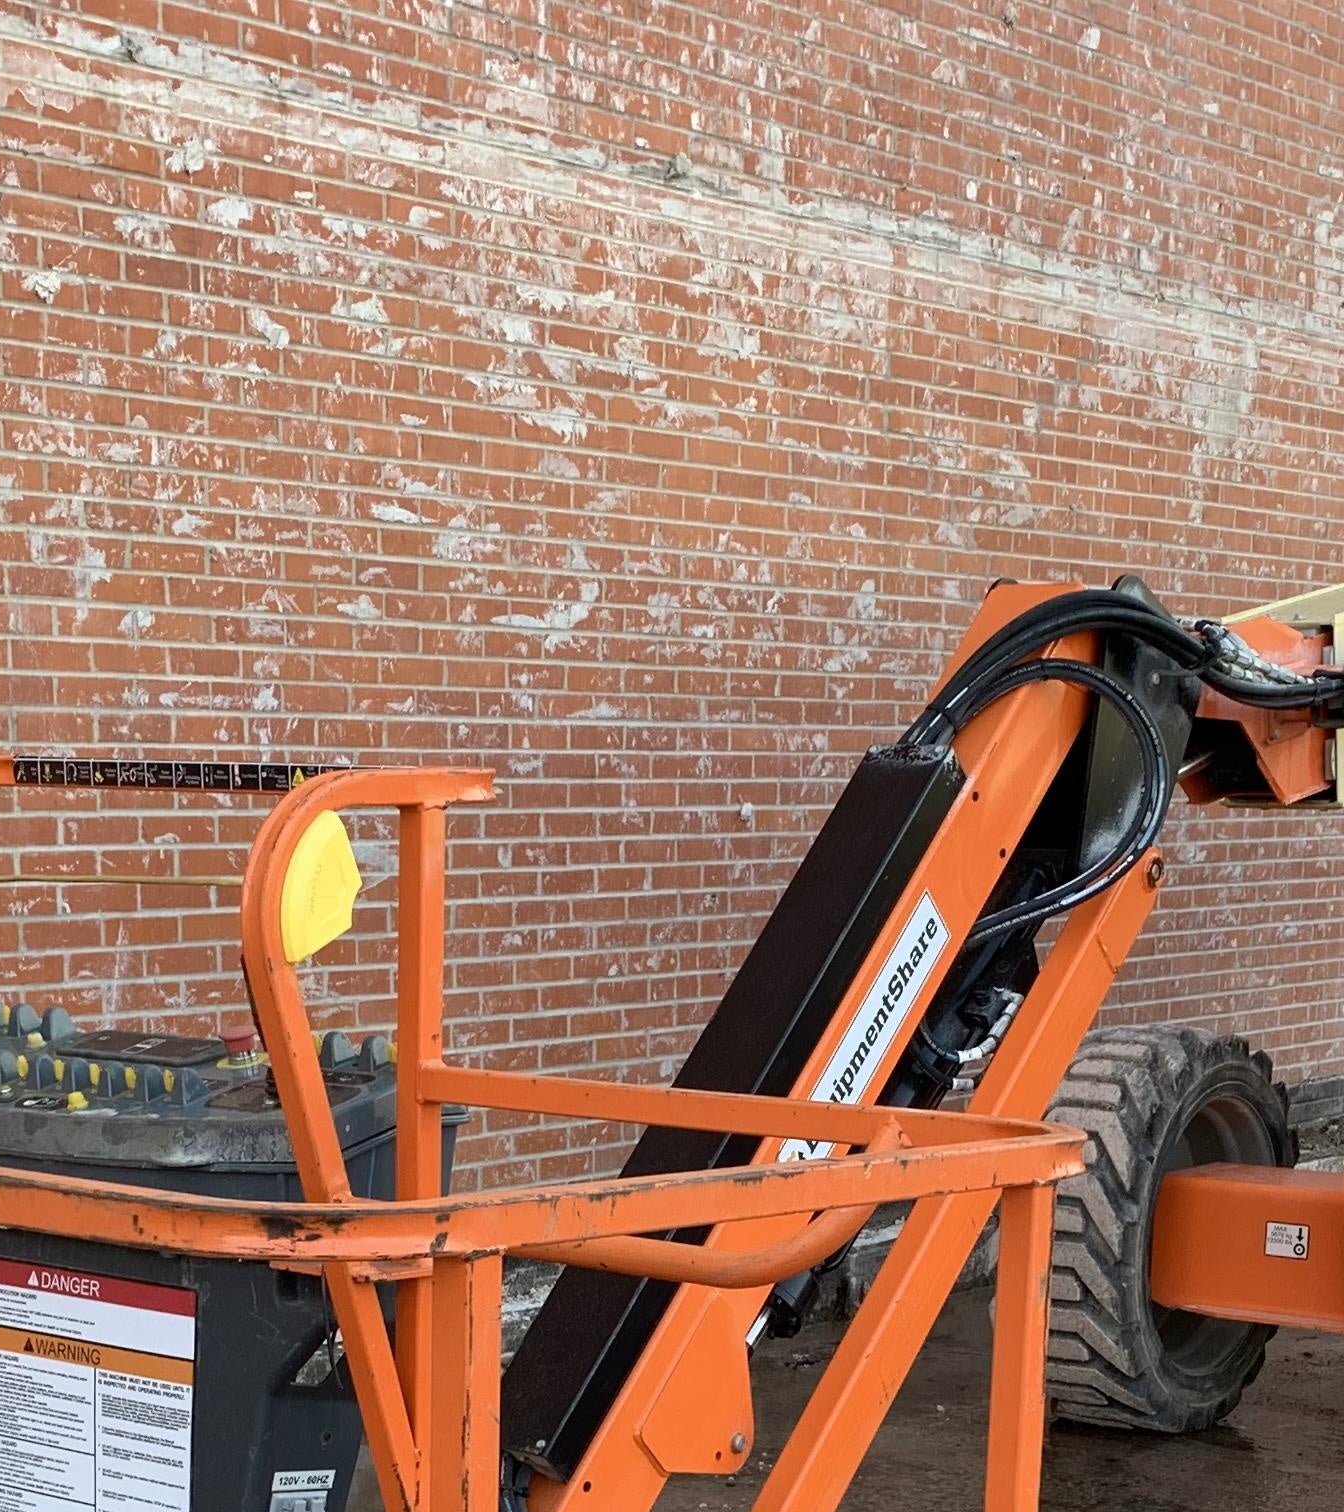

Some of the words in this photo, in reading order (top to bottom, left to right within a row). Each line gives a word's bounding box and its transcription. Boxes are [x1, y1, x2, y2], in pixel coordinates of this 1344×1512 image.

[41, 1272, 100, 1297] DANGER
[35, 1338, 101, 1366] WARNING
[279, 1476, 300, 1486] 120V
[306, 1475, 330, 1485] 60HZ
